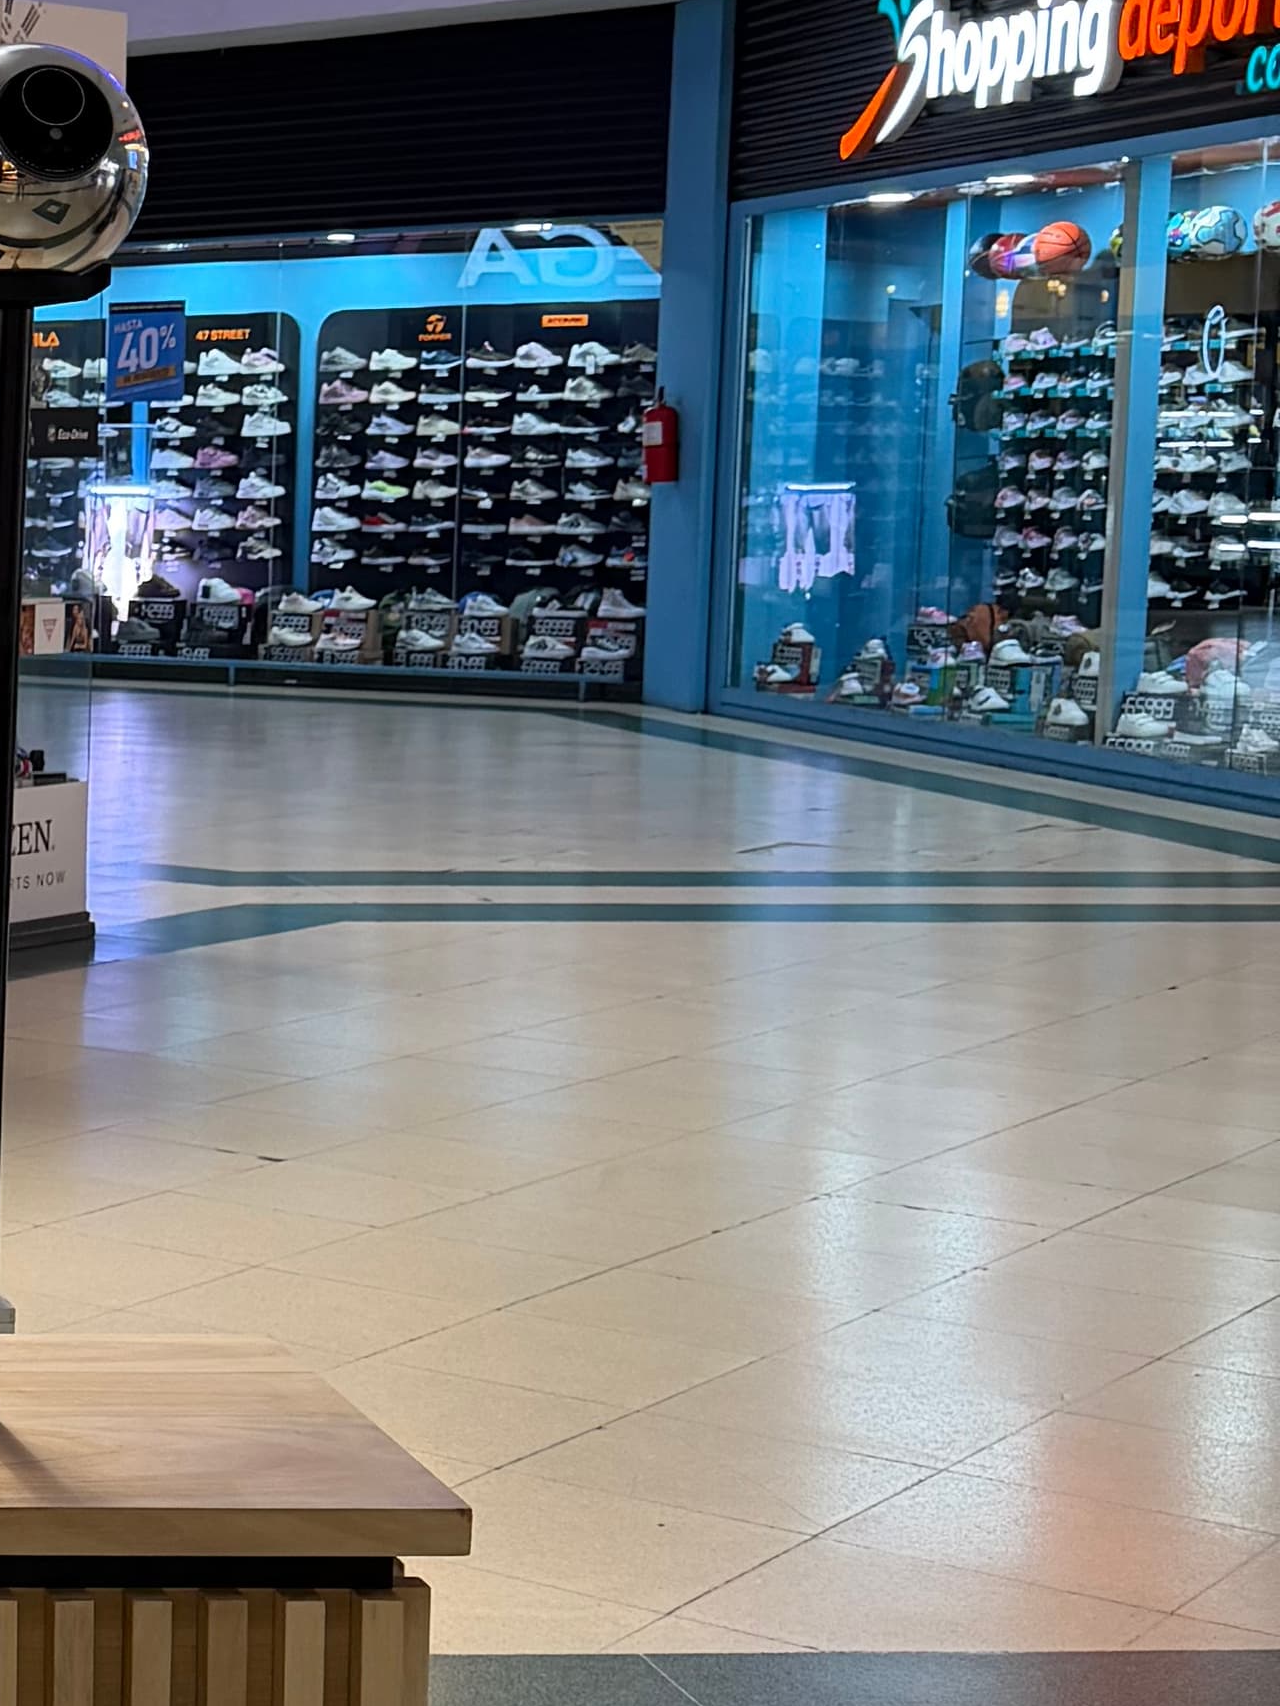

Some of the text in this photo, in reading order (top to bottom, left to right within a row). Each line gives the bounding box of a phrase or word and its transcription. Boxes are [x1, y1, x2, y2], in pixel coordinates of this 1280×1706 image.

[117, 322, 177, 373] 40%
[210, 328, 251, 341] STREET
[11, 819, 55, 856] EN.
[36, 870, 65, 887] NOW
